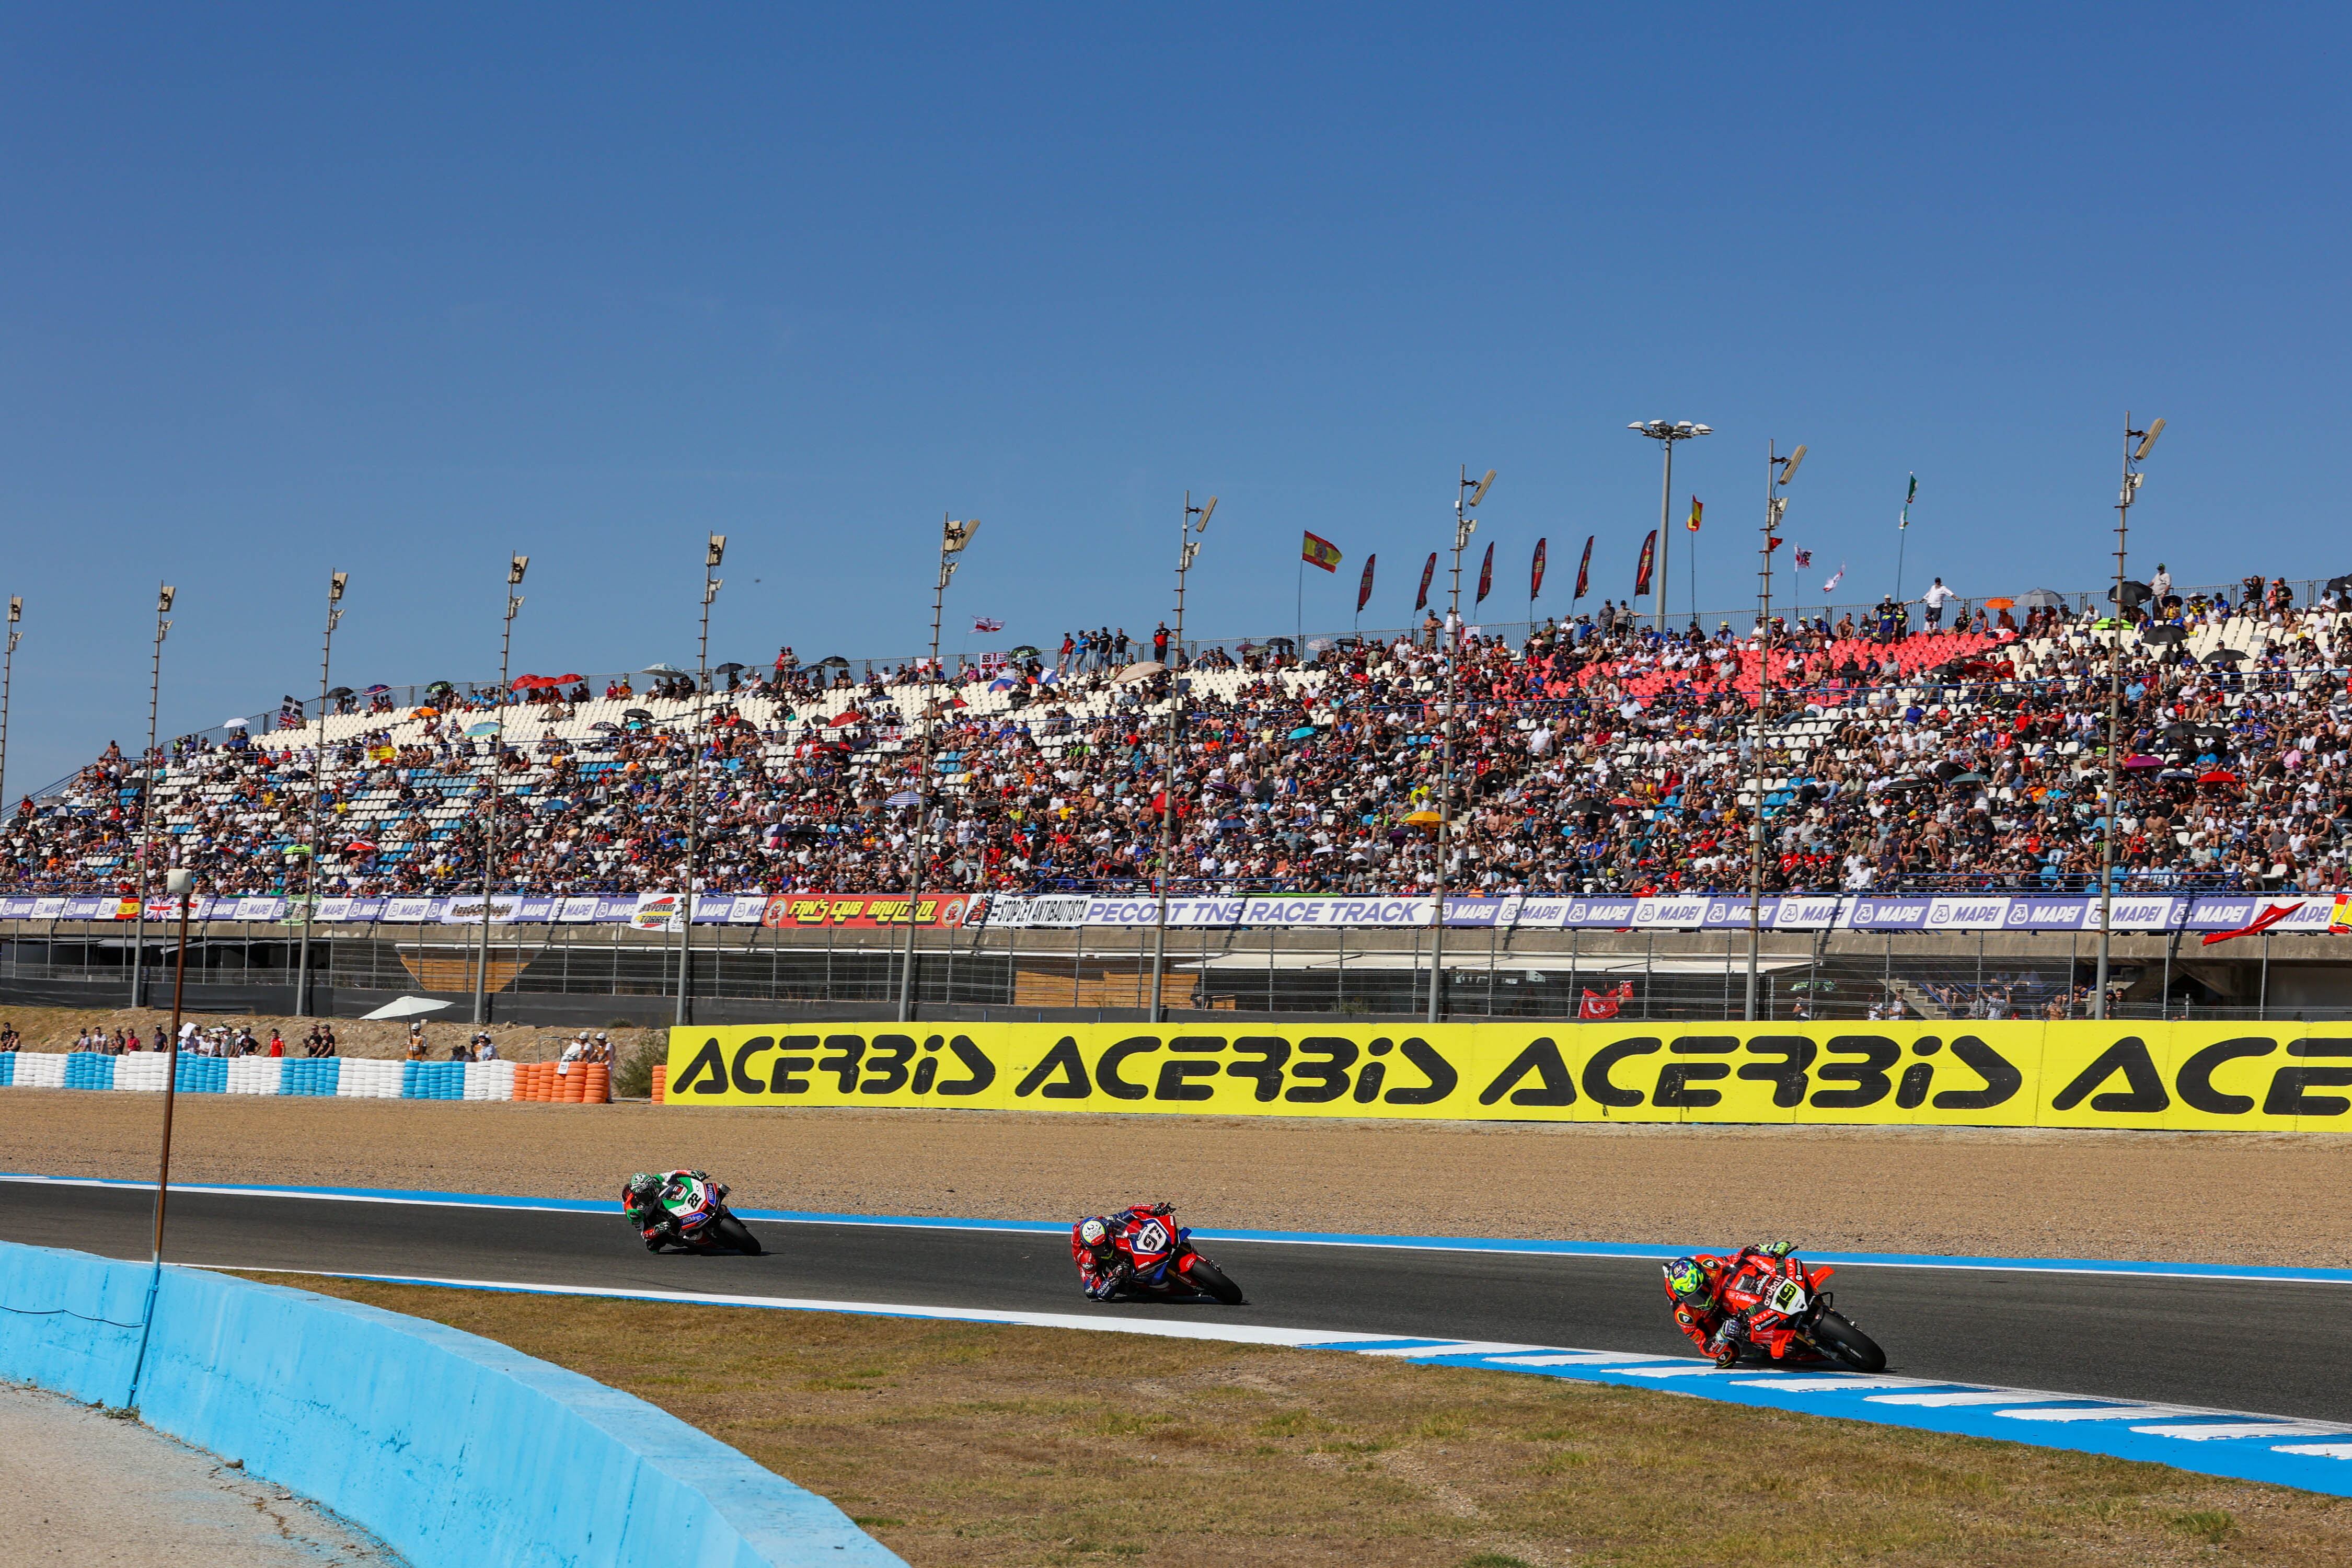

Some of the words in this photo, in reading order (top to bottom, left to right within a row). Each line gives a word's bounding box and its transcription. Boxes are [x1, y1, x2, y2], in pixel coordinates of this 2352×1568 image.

[11, 903, 34, 914] MAPEI
[75, 903, 98, 914] MAPEI
[212, 904, 237, 915] MAPEI
[247, 904, 273, 914] MAPEI
[321, 904, 348, 915] MAPEI
[399, 904, 425, 915] MAPEI
[522, 904, 551, 916] MAPEI
[564, 905, 594, 916] MAPEI
[638, 904, 676, 913] ANTONIO
[699, 904, 732, 916] MAPEI
[788, 898, 830, 922] FAN'S
[1085, 903, 1187, 921] PECOAT
[1193, 903, 1246, 921] TNS
[1248, 903, 1326, 921] RACE
[1329, 903, 1423, 921] TRACK
[1453, 905, 1498, 919] MAPEI
[1518, 906, 1563, 919] MAPEI
[1587, 906, 1633, 920] MAPEI
[1656, 906, 1702, 920] MAPEI
[1726, 906, 1775, 920] MAEI
[1801, 906, 1848, 920] MAPEI
[1874, 906, 1926, 921] MAPEI
[1952, 906, 2002, 921] MAPEI
[2030, 906, 2083, 922] MAPEI
[2111, 906, 2163, 921] MAPEI
[2195, 906, 2248, 922] MAPEI
[2287, 906, 2332, 922] MAPEI
[2052, 1036, 2352, 1115] ACE
[687, 1193, 702, 1210] 22
[1138, 1227, 1147, 1240] HONDA
[1143, 1225, 1163, 1252] 97
[1775, 1282, 1797, 1311] 19
[1750, 1310, 1774, 1324] ALTEN
[1759, 1315, 1779, 1328] motorola
